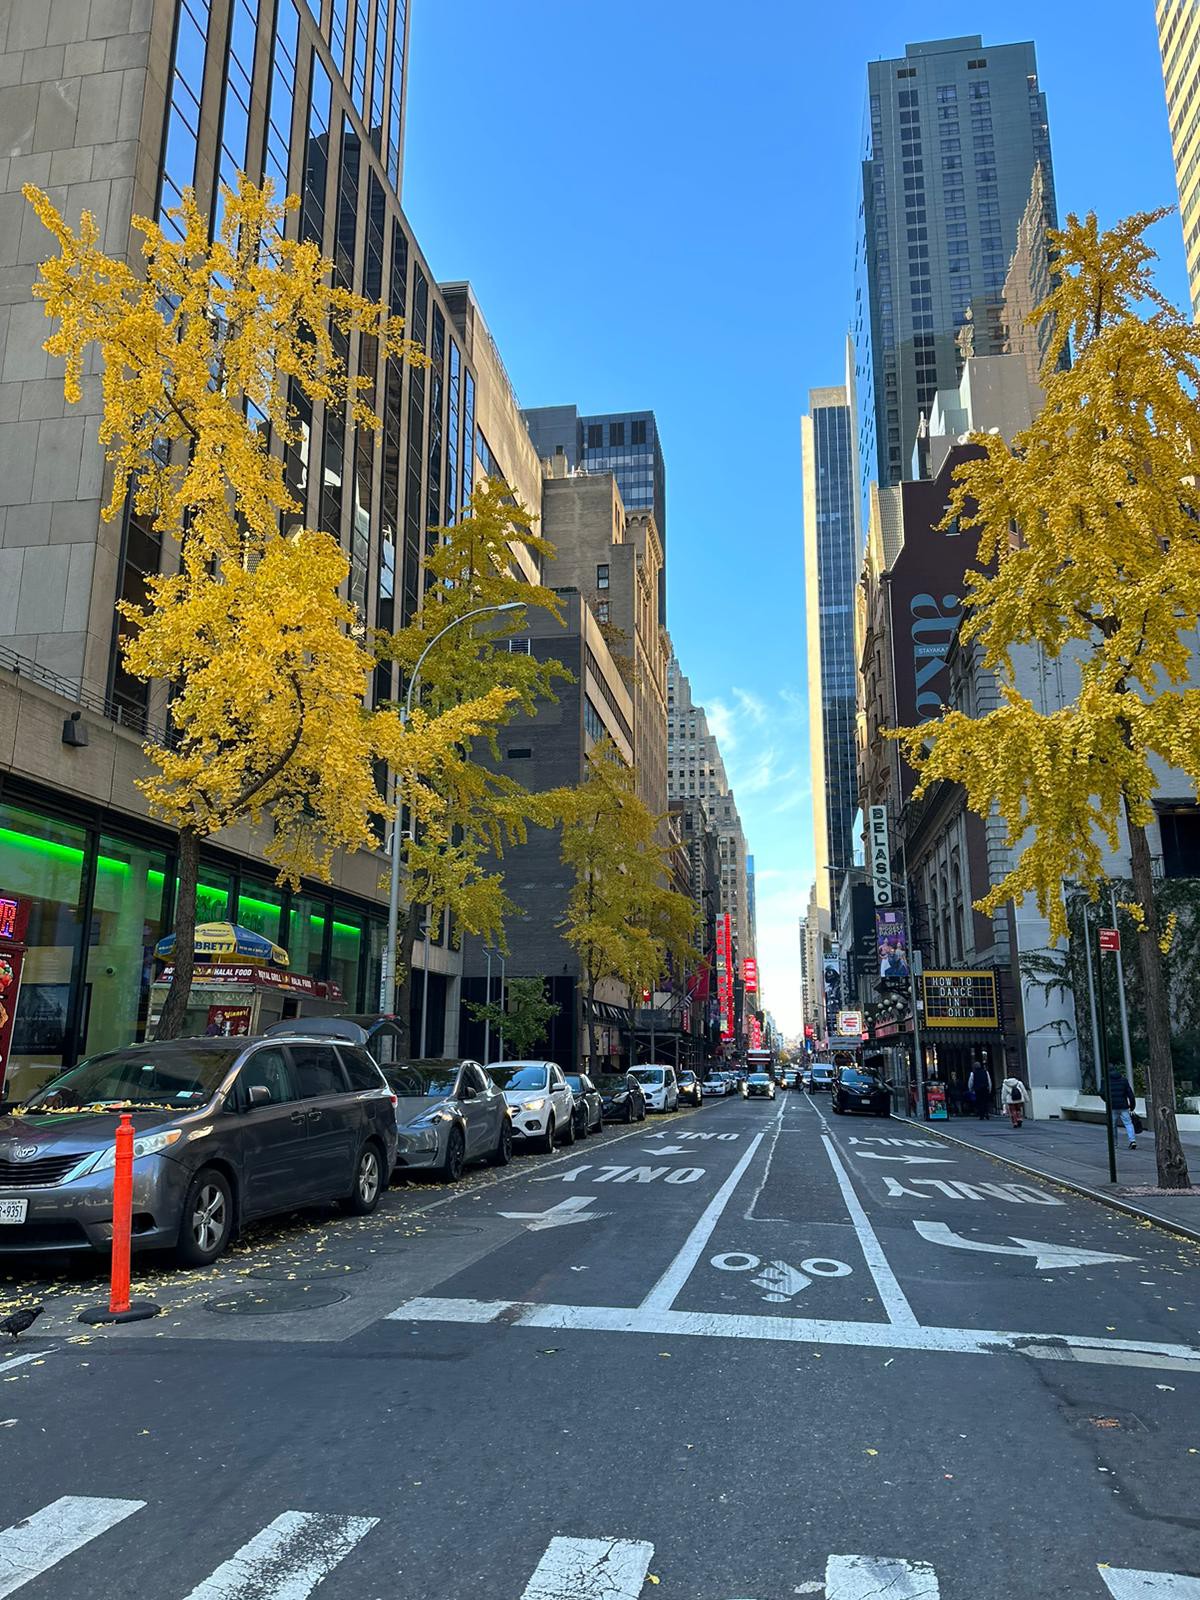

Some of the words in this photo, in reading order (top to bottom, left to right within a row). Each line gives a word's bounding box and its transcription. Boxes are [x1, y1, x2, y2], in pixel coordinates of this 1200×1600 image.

[872, 808, 890, 904] BELASCO
[193, 942, 233, 951] BRETT
[213, 968, 233, 976] HALAL
[235, 968, 252, 976] FOOD
[932, 977, 952, 986] HOW
[960, 977, 972, 986] TO
[940, 987, 973, 997] DANCE
[948, 997, 960, 1007] IN
[948, 1008, 974, 1017] OHIO
[644, 1131, 740, 1141] ONLY
[848, 1136, 951, 1149] ONLY
[531, 1165, 706, 1184] ONLY
[882, 1176, 1068, 1206] ONLY
